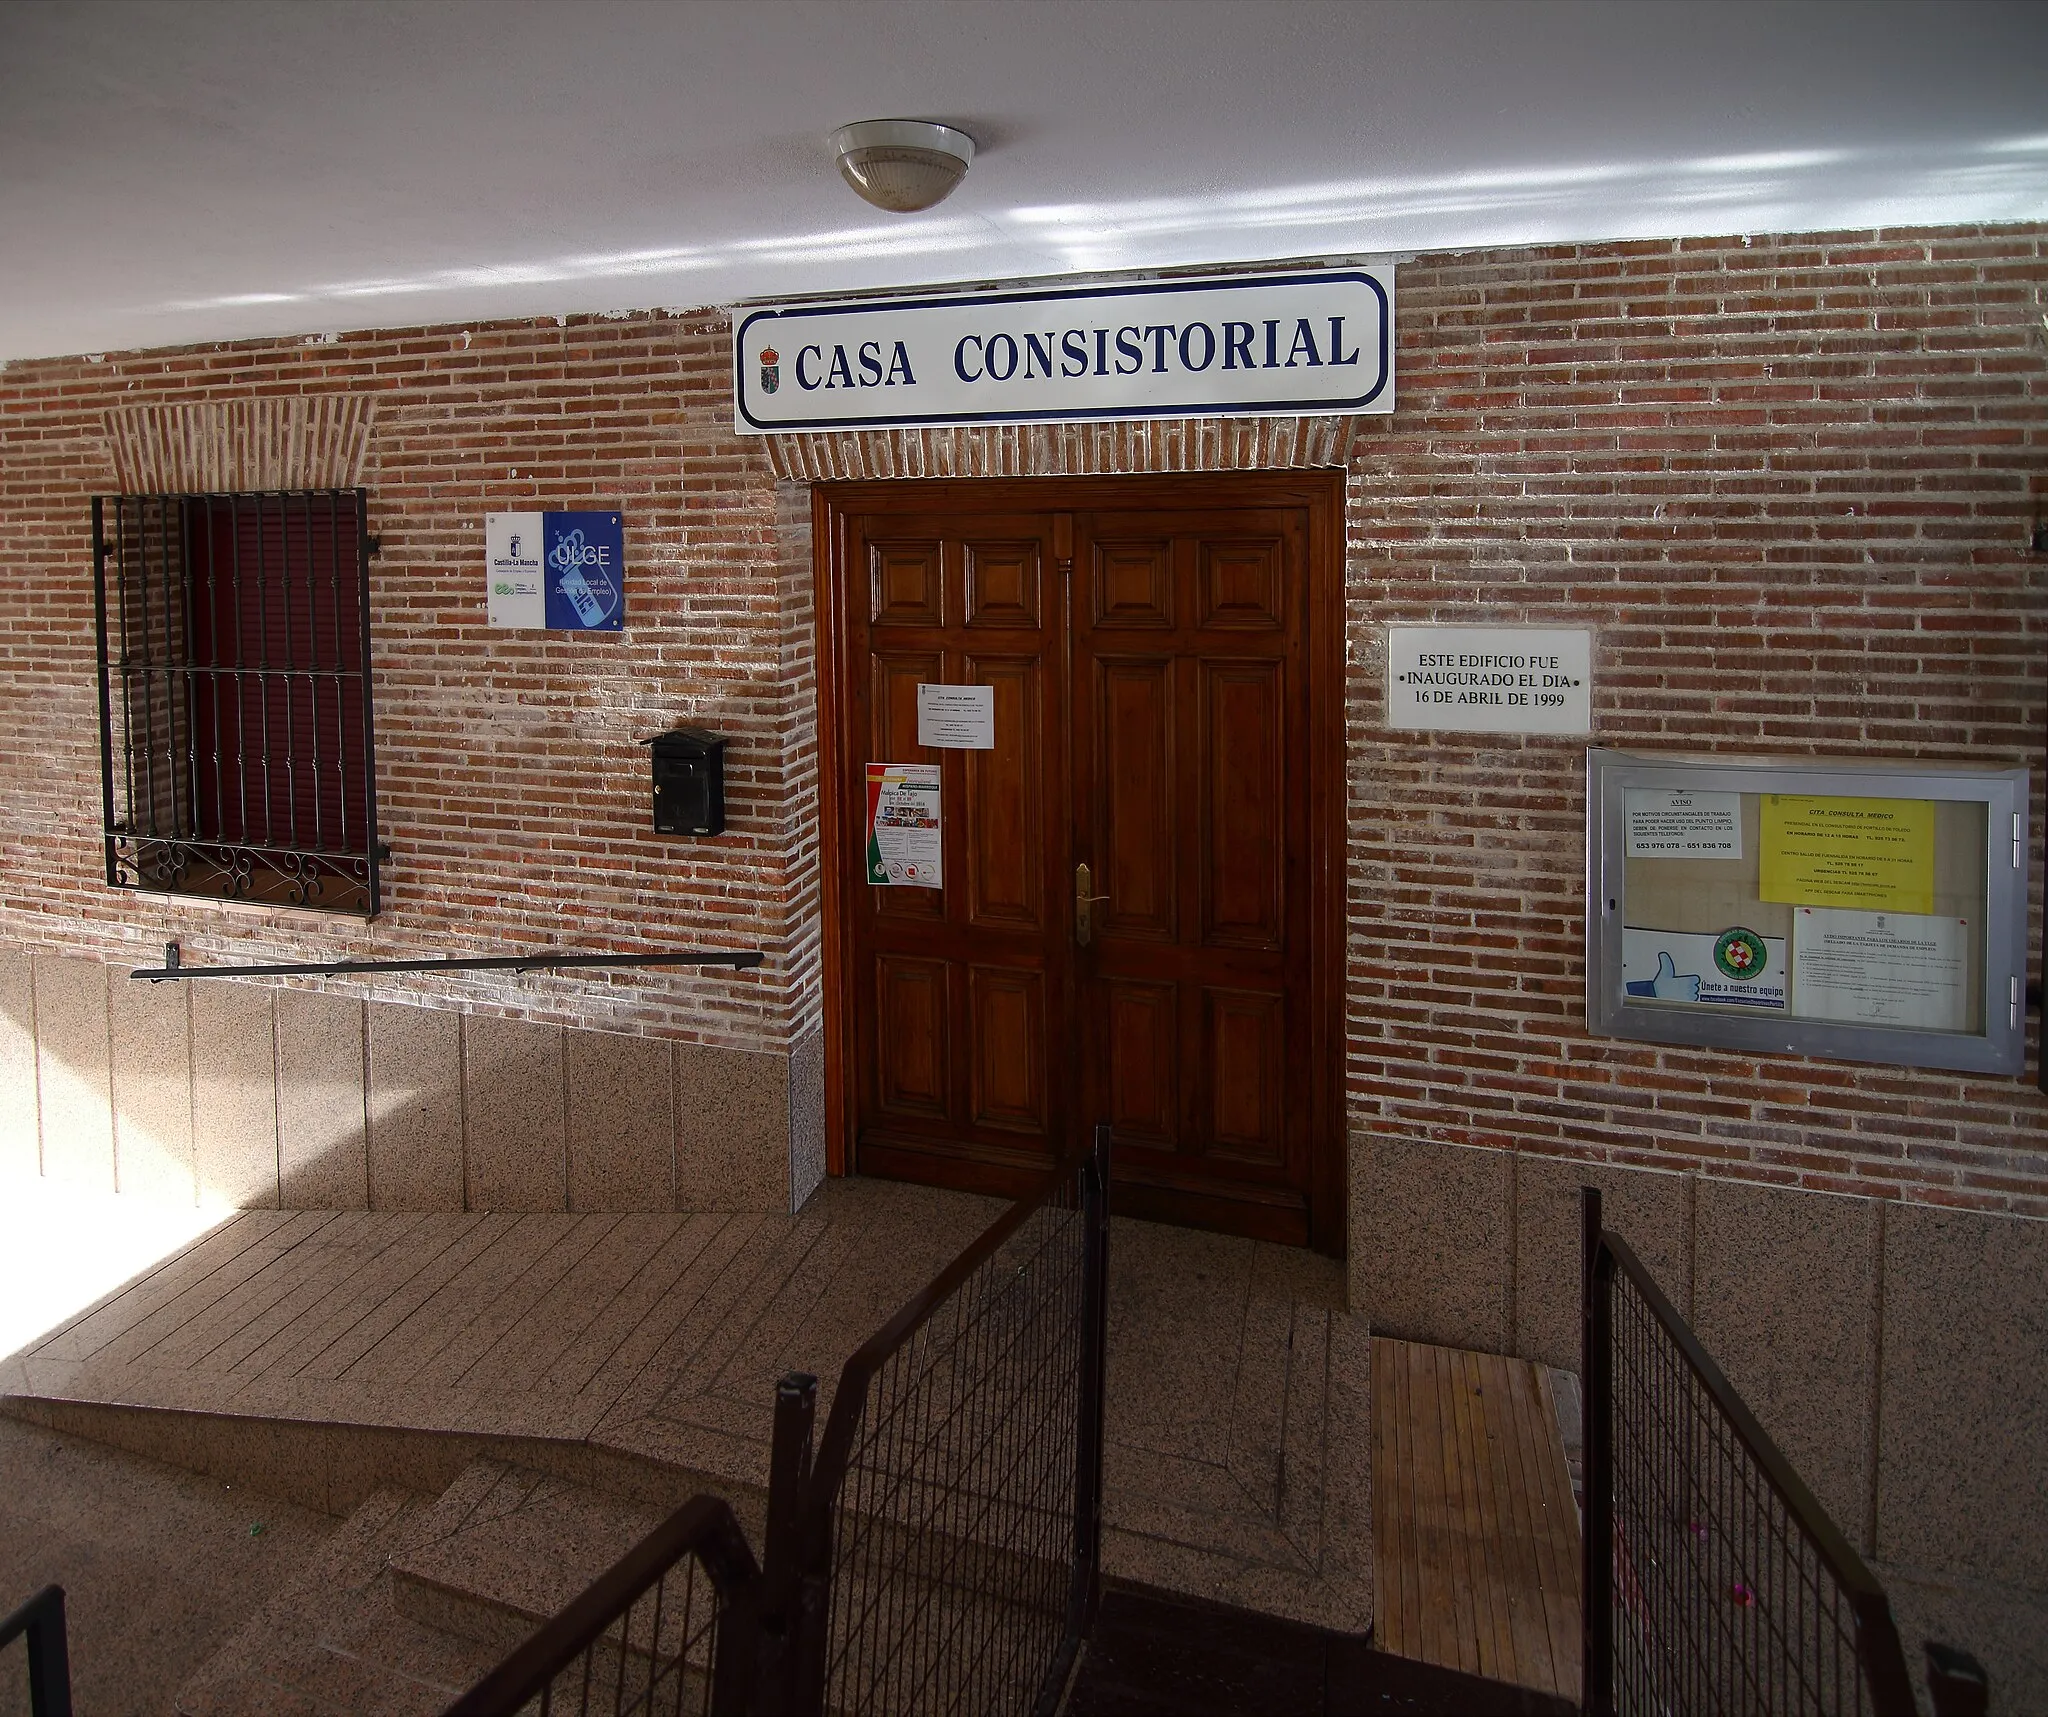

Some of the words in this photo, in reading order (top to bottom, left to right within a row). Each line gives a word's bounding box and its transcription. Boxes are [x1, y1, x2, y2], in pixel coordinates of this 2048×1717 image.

[795, 341, 917, 391] CASA
[952, 316, 1361, 383] CONSISTORIAL
[557, 545, 610, 565] ULGE
[1419, 654, 1454, 667] ESTE
[1459, 655, 1525, 668] EDIFICIO
[1529, 656, 1559, 669] FUE
[1407, 672, 1514, 686] INAUGURADO
[1518, 674, 1537, 687] EL
[1416, 690, 1429, 703] 16
[1434, 691, 1453, 703] DE
[1458, 692, 1503, 704] ABRIL
[1508, 693, 1528, 705] DE
[1534, 694, 1564, 706] 1999
[1701, 980, 1722, 992] Únete
[1730, 985, 1757, 994] nuestro
[1760, 986, 1783, 997] equipo
